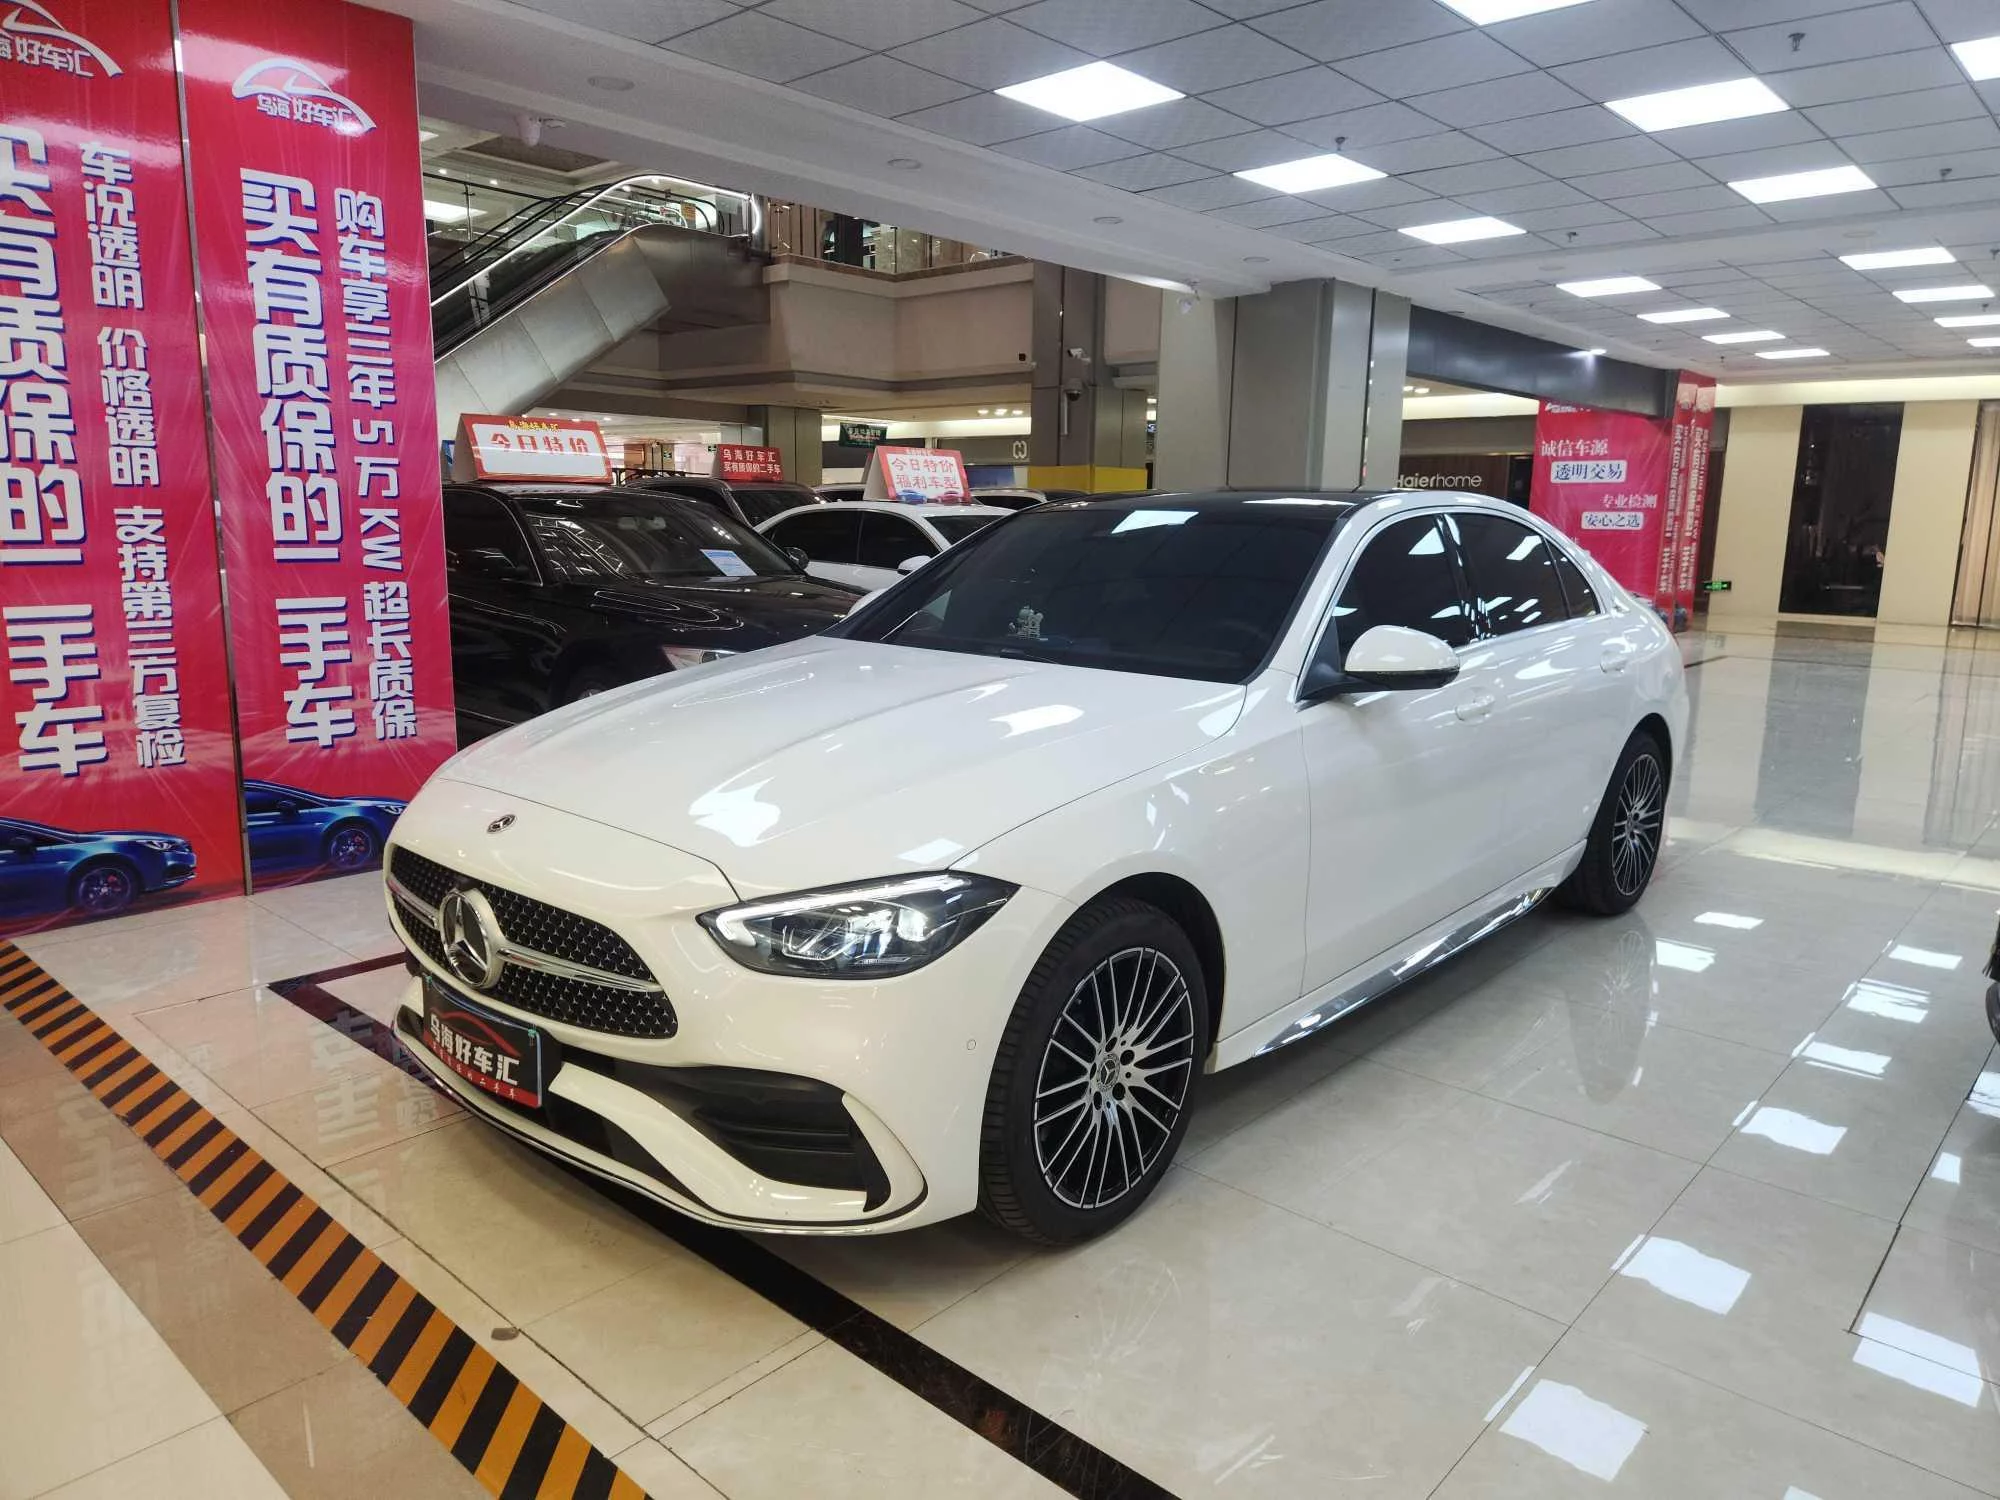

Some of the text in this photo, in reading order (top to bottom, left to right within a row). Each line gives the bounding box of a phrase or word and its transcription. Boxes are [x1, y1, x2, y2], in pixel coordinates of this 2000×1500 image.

[257, 94, 353, 128] 乌海好车汇
[491, 433, 590, 456] 今日特价
[1541, 439, 1608, 457] 诚信车源
[80, 142, 185, 768] 车况透明 价格透明 支持第三方复检
[239, 168, 356, 748] 买有质保的二手车
[723, 449, 776, 463] 乌海好车汇
[892, 458, 954, 474] 今日特价
[1555, 463, 1623, 480] 透明交易
[896, 475, 961, 490] 福利车型
[1602, 494, 1658, 508] 专业检测
[1586, 514, 1640, 527] 安心之选
[430, 1014, 520, 1086] 乌海好车汇
